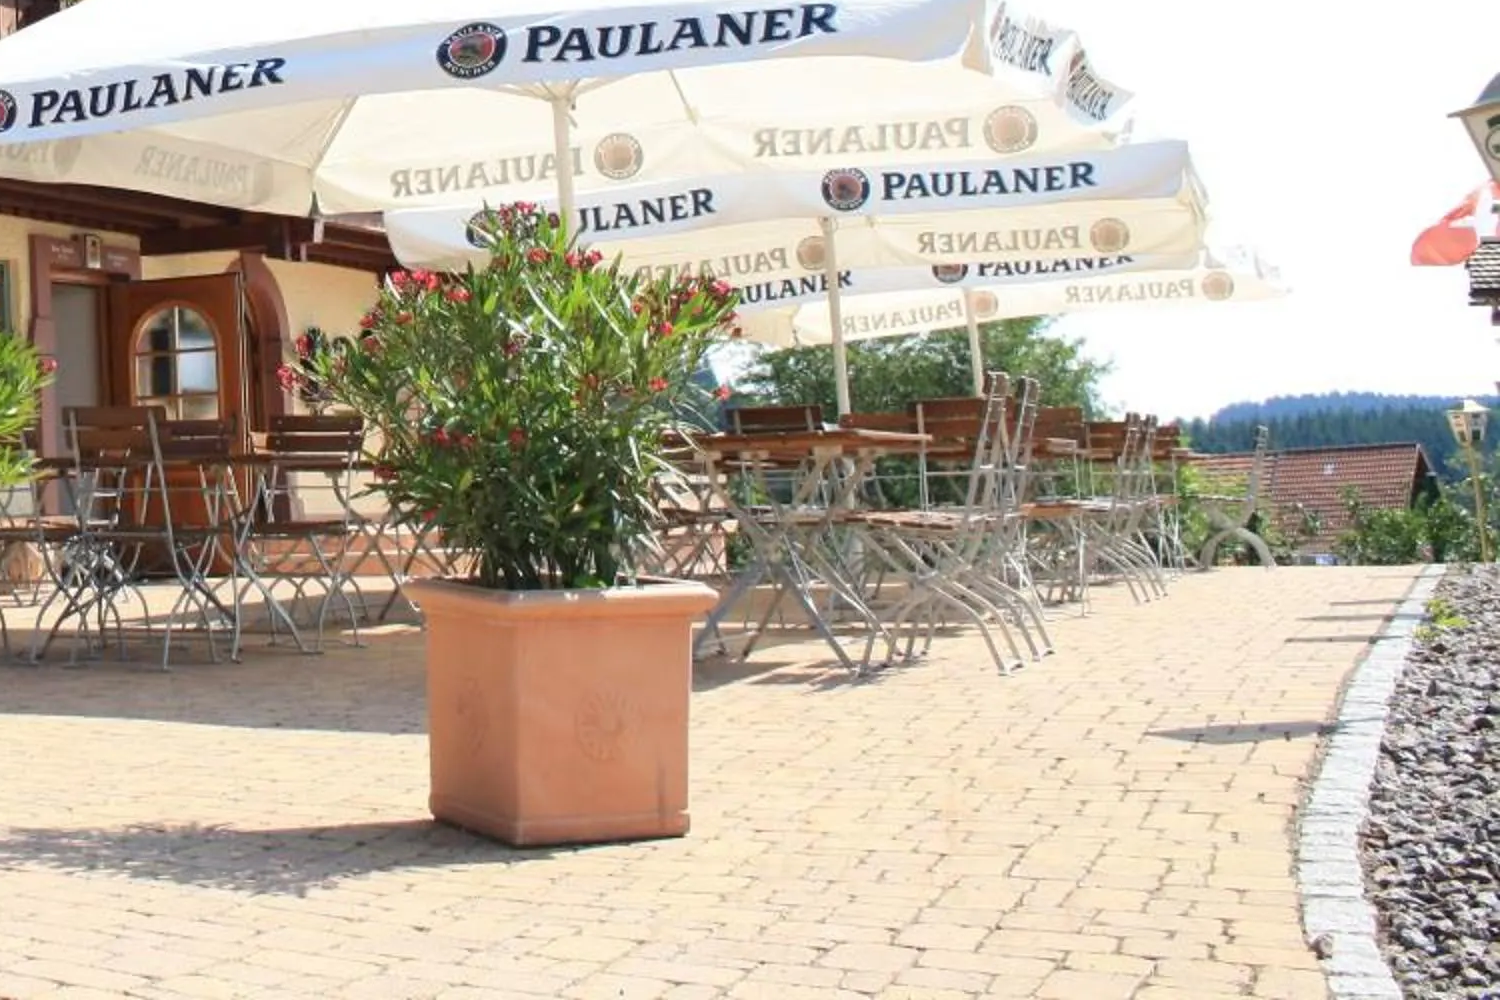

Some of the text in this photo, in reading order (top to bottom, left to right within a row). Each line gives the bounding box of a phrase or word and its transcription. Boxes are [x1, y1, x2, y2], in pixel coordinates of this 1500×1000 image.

[521, 2, 838, 62] PAULANER
[27, 57, 286, 128] PAULANER
[881, 161, 1098, 201] PAULANER
